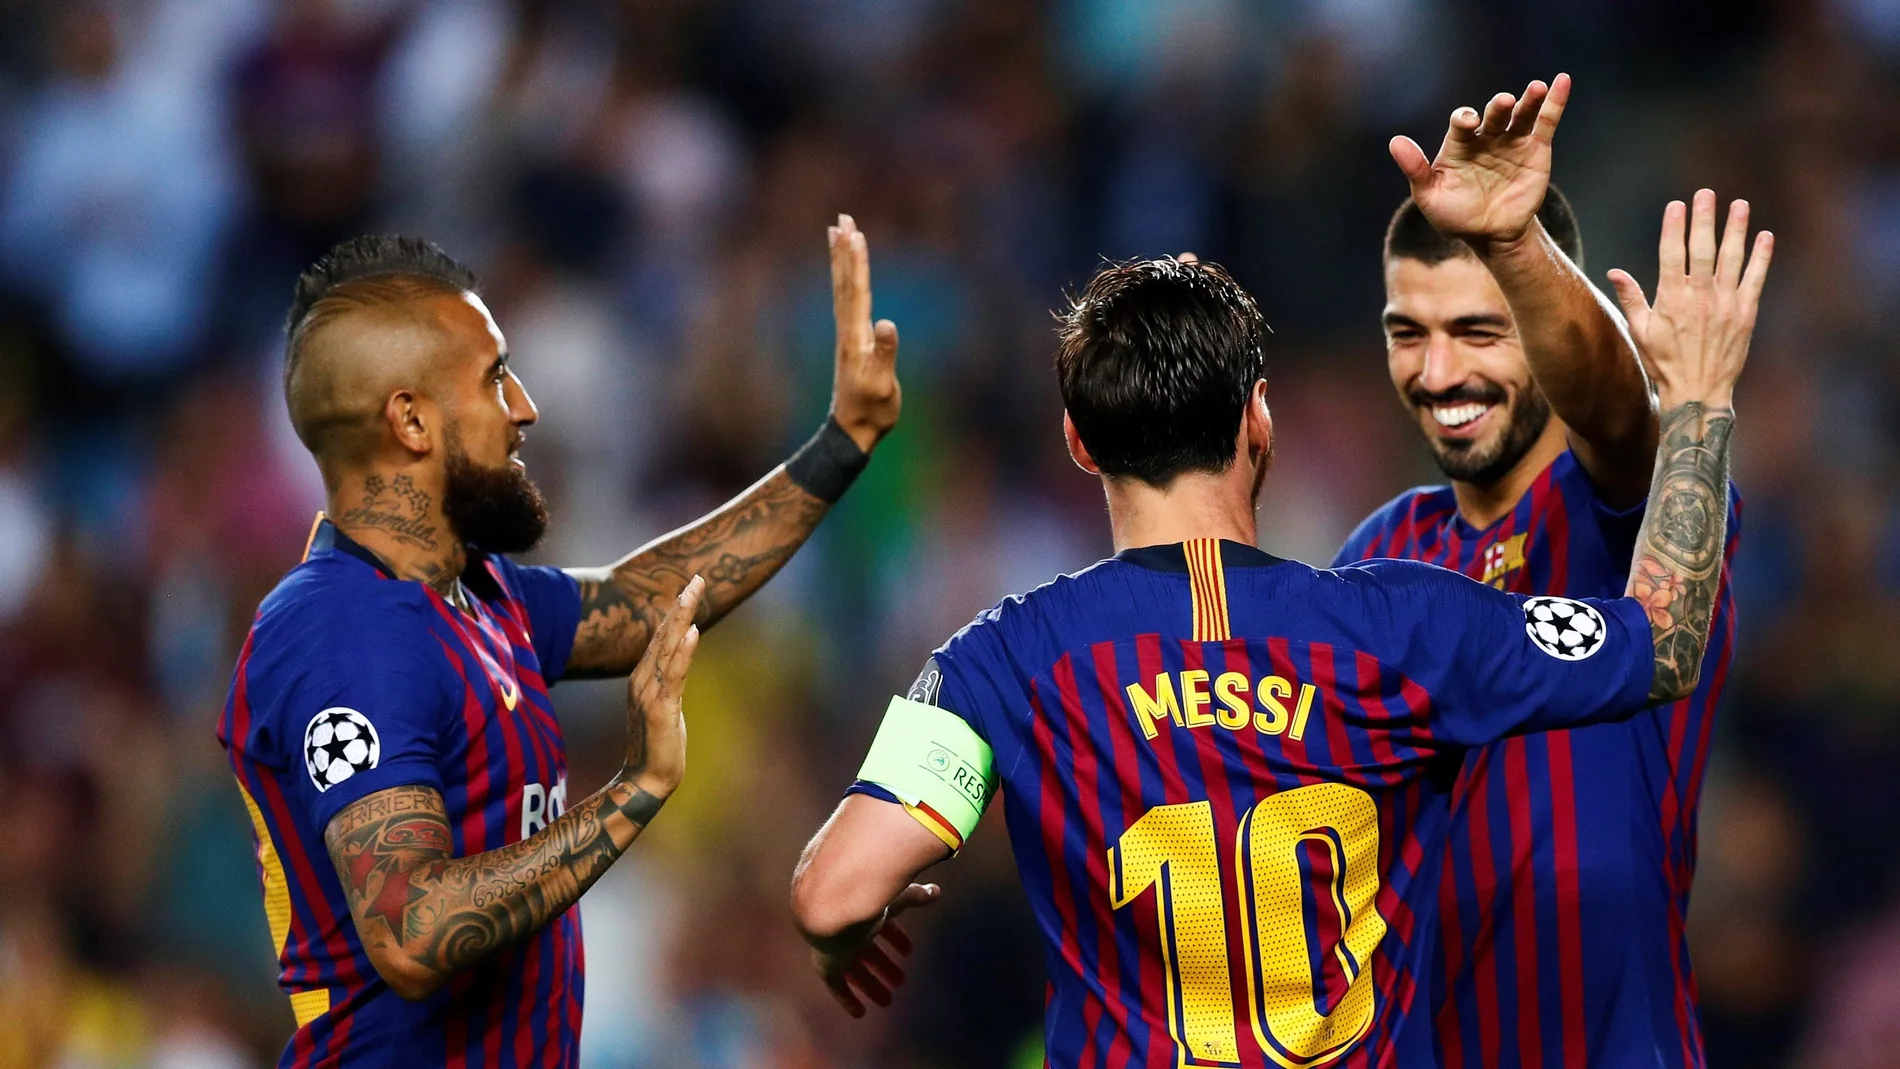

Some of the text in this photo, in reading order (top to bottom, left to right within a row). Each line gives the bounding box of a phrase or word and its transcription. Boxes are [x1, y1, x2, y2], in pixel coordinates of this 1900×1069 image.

[1126, 669, 1317, 741] MESSI
[336, 791, 445, 834] ERRIERO
[521, 771, 567, 841] Ra
[1107, 782, 1387, 1069] 10
